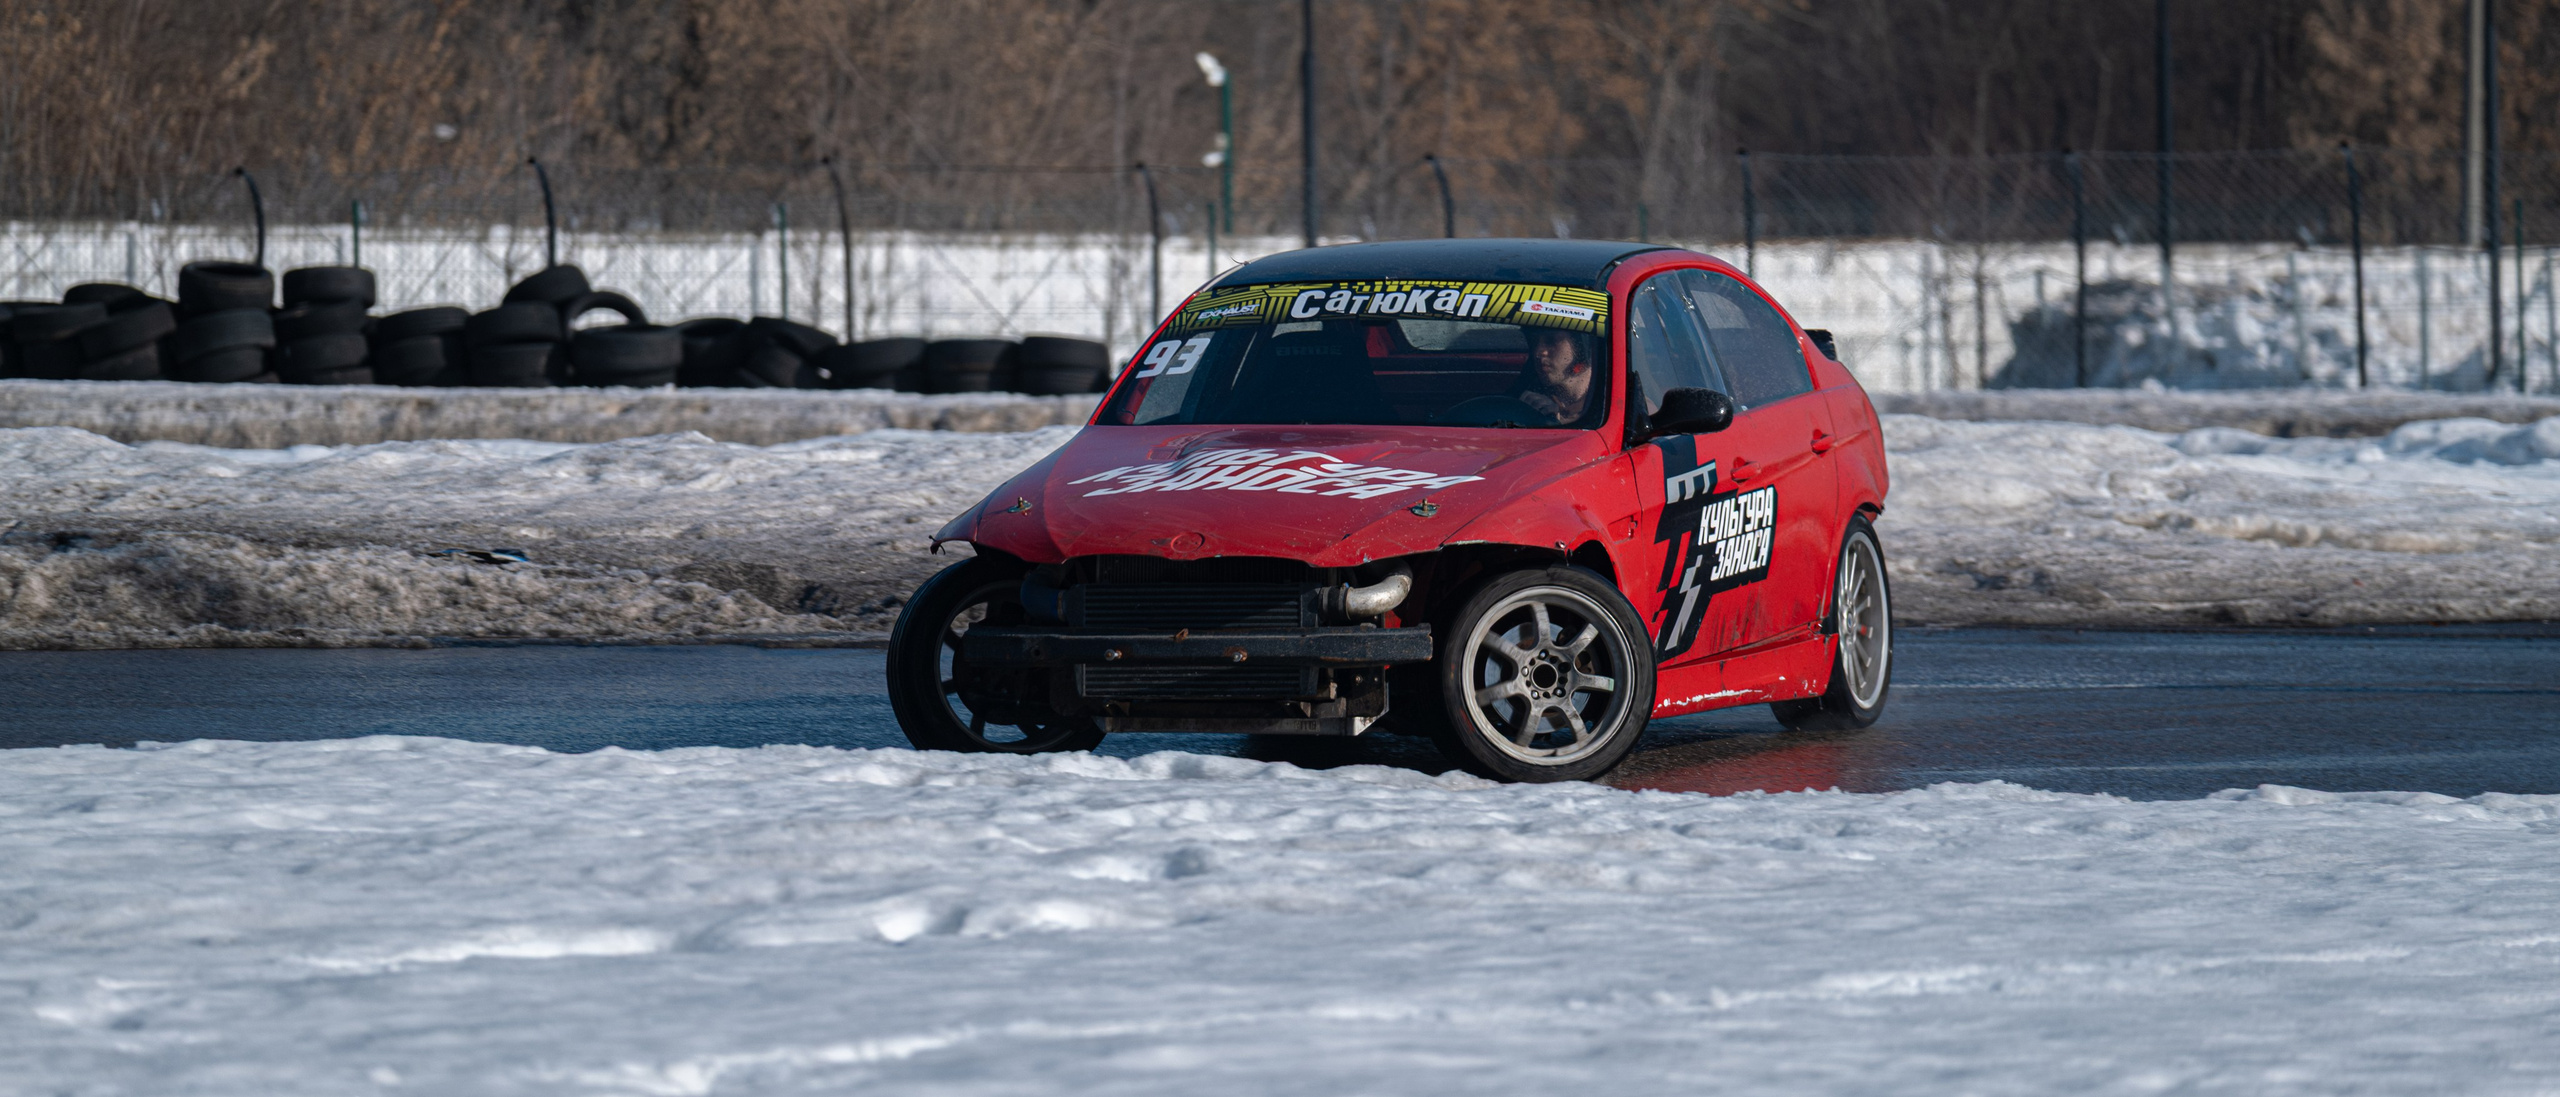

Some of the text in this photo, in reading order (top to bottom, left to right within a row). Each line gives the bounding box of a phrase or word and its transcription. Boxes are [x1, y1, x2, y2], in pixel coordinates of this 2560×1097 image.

[1544, 307, 1585, 317] TAKAYAMA
[1136, 337, 1211, 379] 93
[1083, 465, 1413, 500] ЗАНОСА
[1698, 487, 1775, 546] КУЛЬТУРА
[1710, 527, 1772, 581] ЗАНОСА
